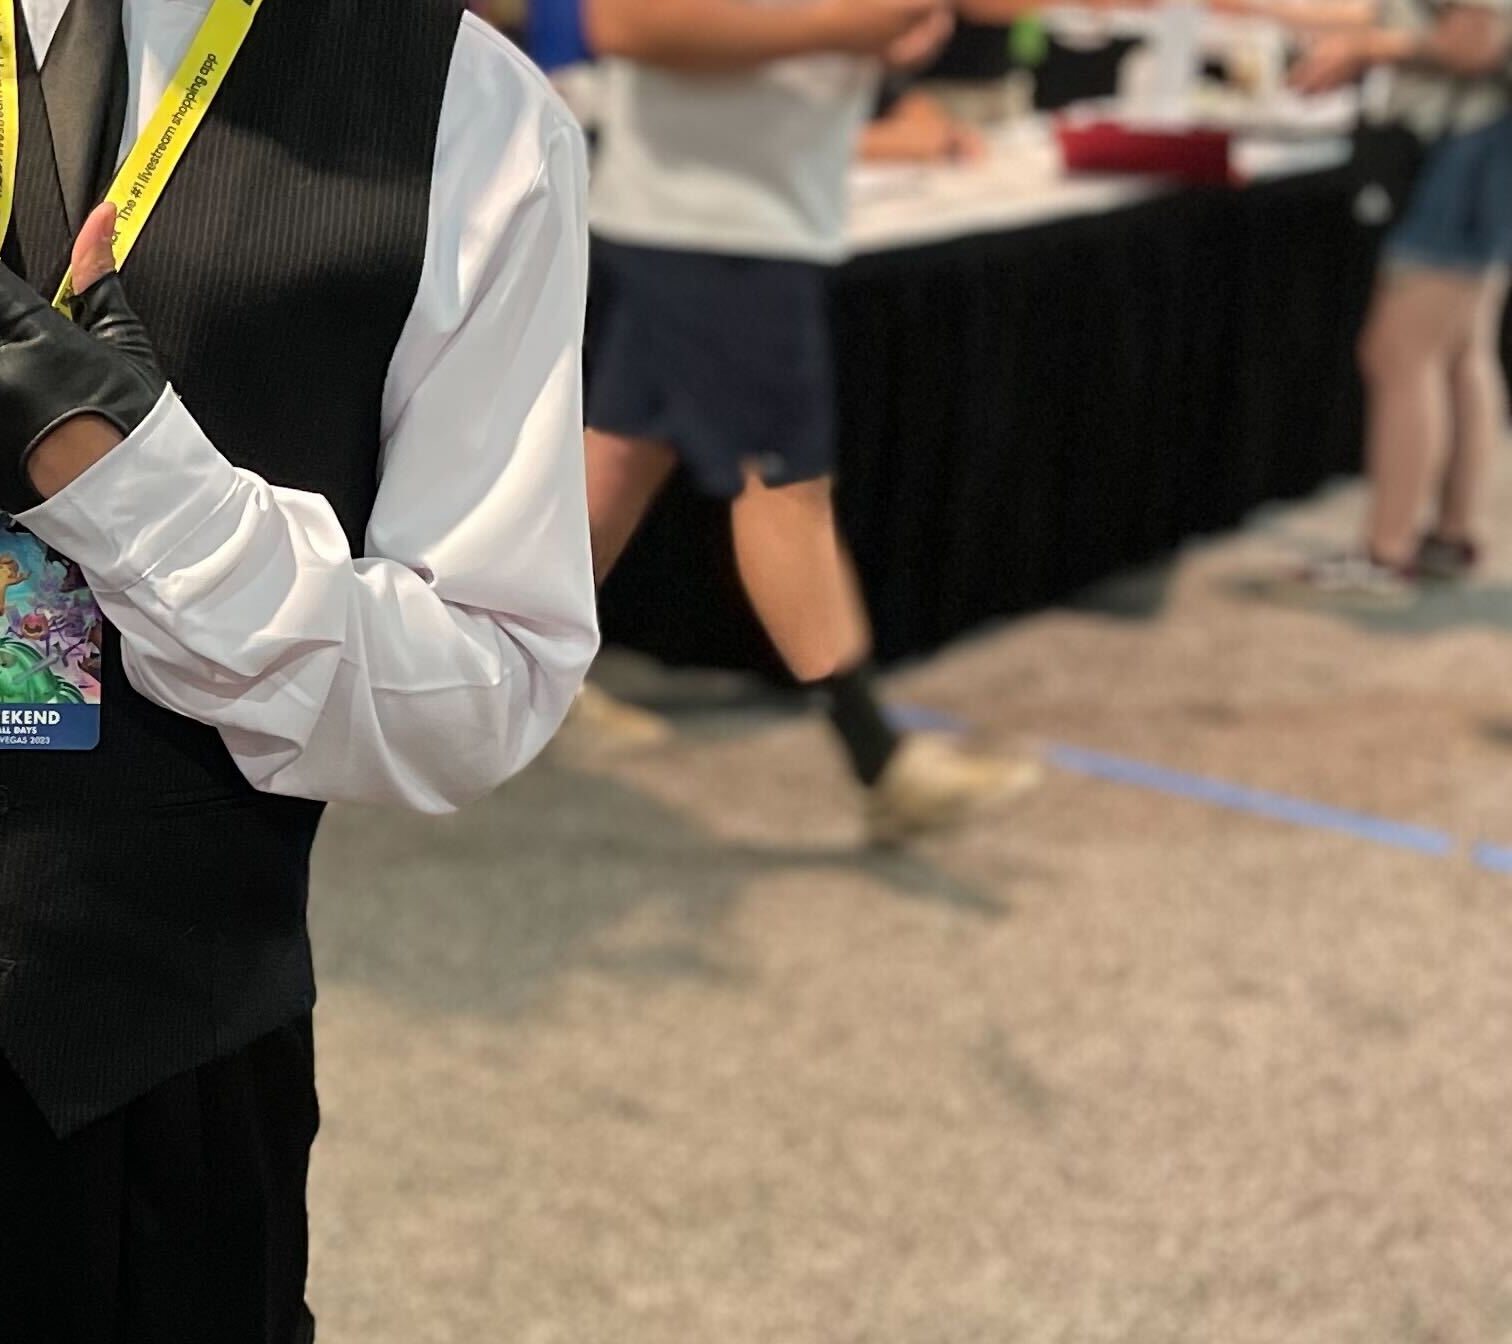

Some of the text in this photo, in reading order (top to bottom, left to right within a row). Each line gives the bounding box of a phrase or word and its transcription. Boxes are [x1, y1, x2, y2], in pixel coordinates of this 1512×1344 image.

[118, 53, 218, 222] The #1 livestream shopping app
[13, 726, 38, 735] DAYS
[0, 736, 28, 745] VEGAS
